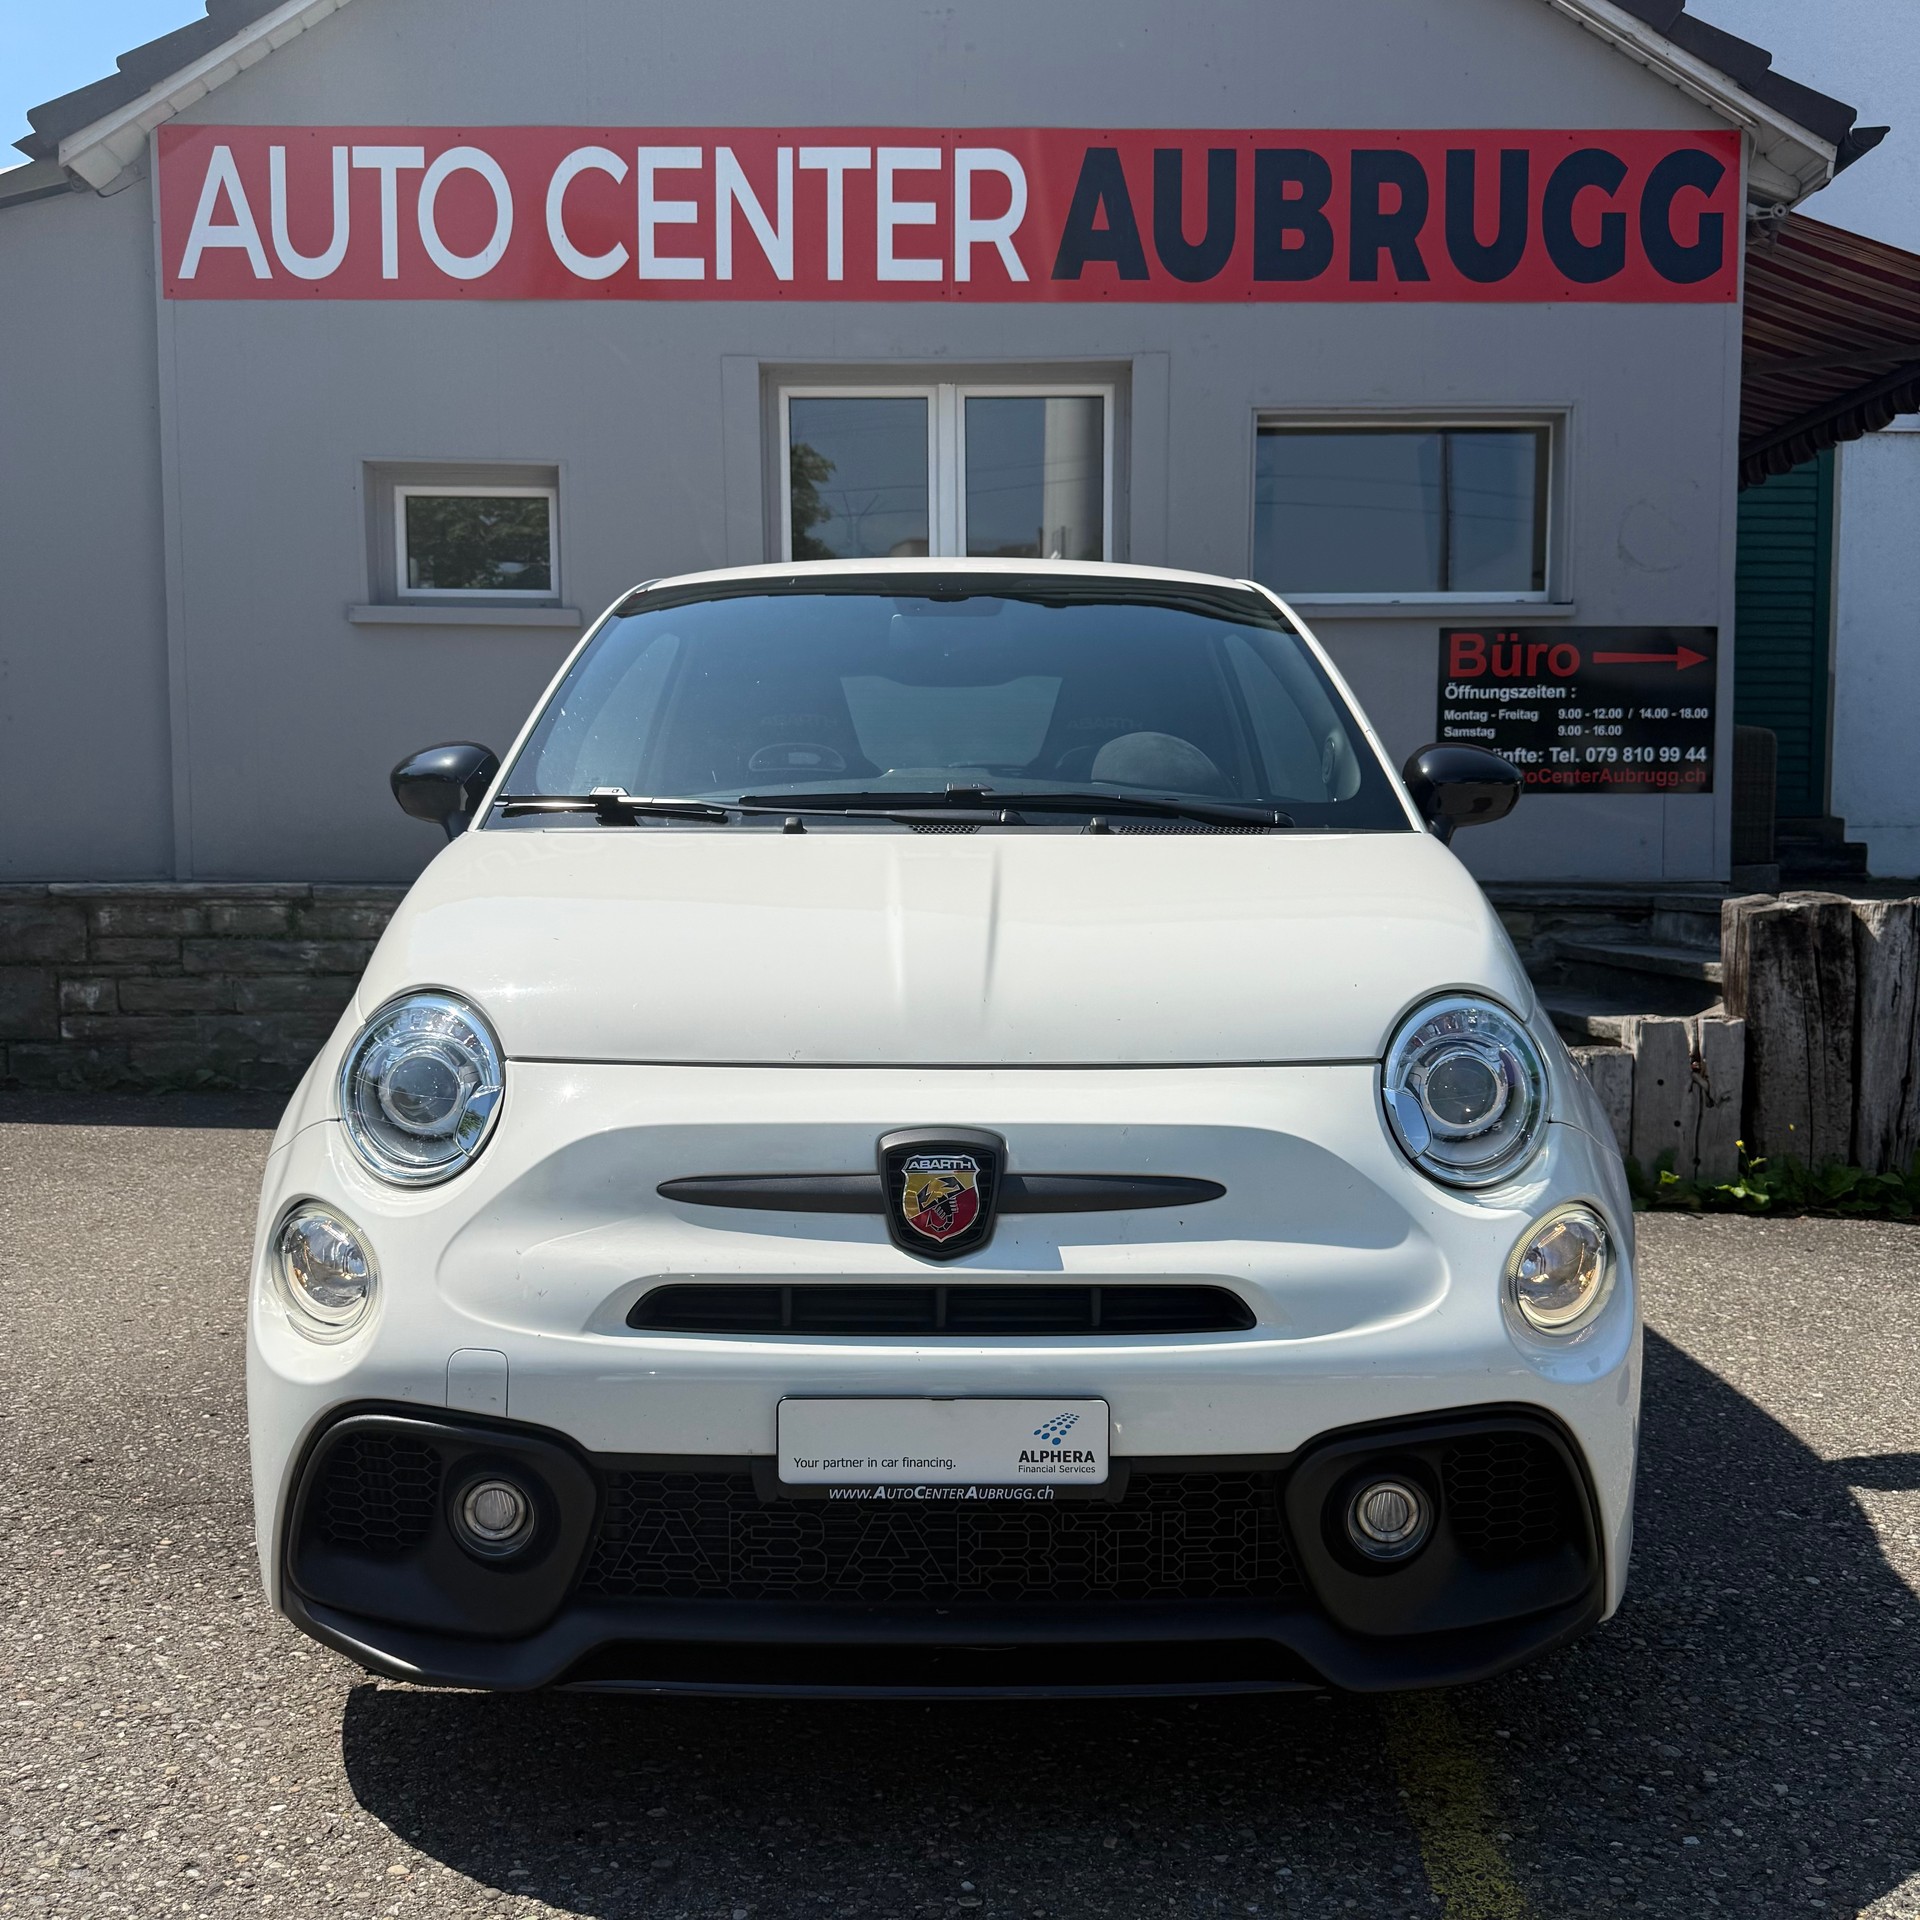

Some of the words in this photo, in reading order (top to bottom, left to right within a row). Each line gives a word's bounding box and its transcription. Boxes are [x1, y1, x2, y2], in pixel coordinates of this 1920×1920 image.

[178, 146, 514, 280] AUTO
[545, 146, 1030, 282] CENTER
[1051, 147, 1727, 285] AUBRUGG
[1448, 632, 1581, 678] Büro
[1444, 682, 1566, 702] Öffnungszeiten
[1443, 709, 1489, 722] Montag
[1498, 708, 1539, 722] Freitag
[1557, 708, 1582, 719] 9.00
[1593, 708, 1623, 719] 12.00
[1639, 707, 1669, 719] 14.00
[1679, 707, 1709, 719] 18.00
[1443, 726, 1496, 739] Samstag
[1557, 725, 1582, 736] 9.00
[1593, 725, 1623, 736] 16.00
[1549, 747, 1580, 763] Tel.
[1585, 747, 1617, 763] 079
[1622, 747, 1654, 762] 810
[1659, 747, 1680, 762] 99
[1684, 746, 1707, 762] 44
[908, 1160, 972, 1169] ABARTH
[793, 1457, 819, 1468] Your
[823, 1458, 864, 1470] partner
[867, 1457, 878, 1468] in
[881, 1459, 899, 1468] car
[902, 1456, 956, 1470] financing.
[1018, 1450, 1096, 1463] ALPHERA
[1018, 1465, 1056, 1473] Financial
[1059, 1465, 1096, 1473] Services
[609, 1508, 1259, 1584] ABARTH
